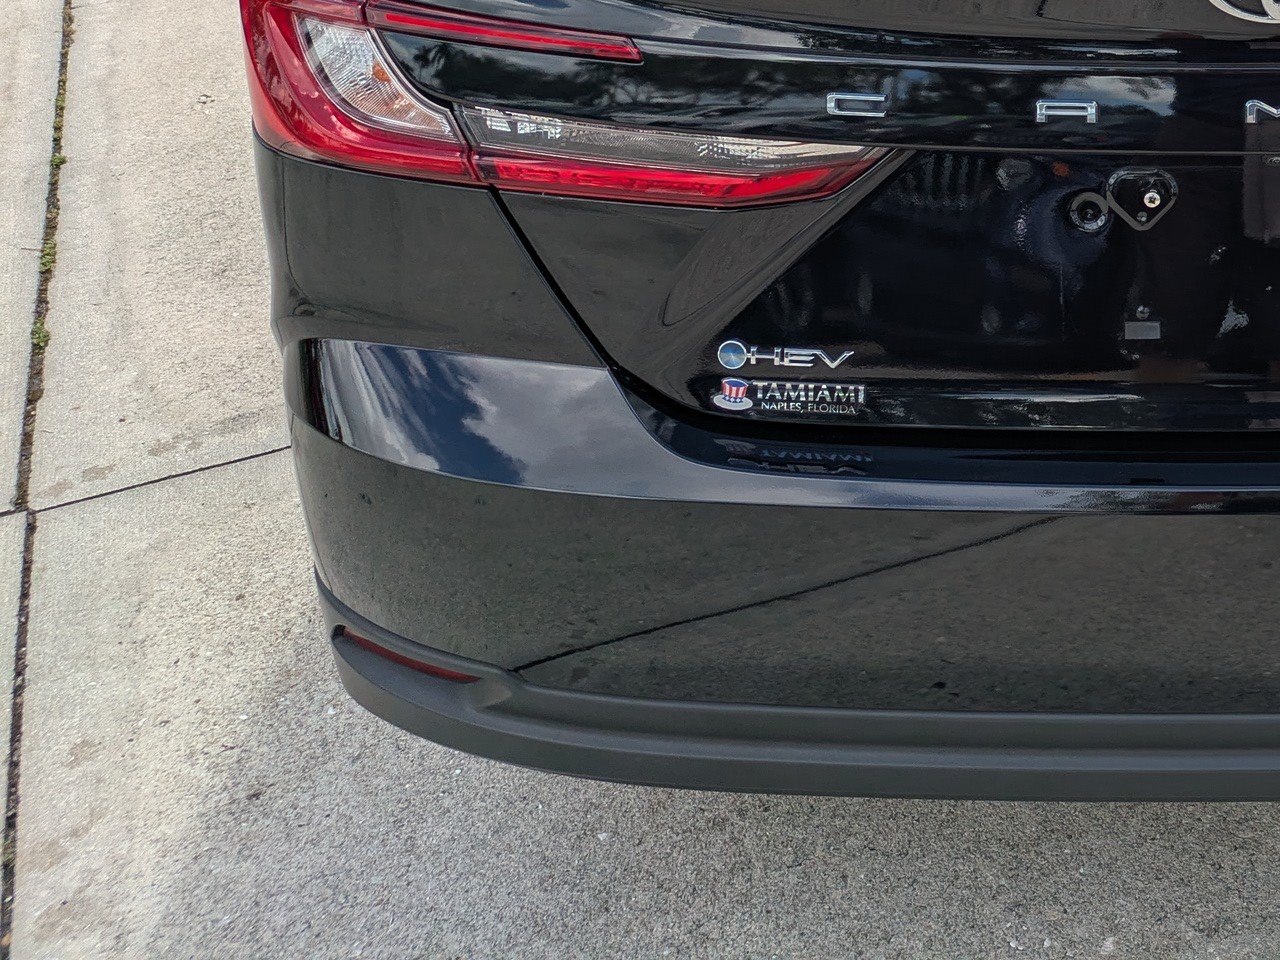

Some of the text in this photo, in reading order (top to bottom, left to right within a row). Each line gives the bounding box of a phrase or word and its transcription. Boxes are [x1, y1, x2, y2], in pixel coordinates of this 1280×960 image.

[750, 346, 855, 369] HEV
[753, 381, 866, 404] TAMIAMI
[761, 401, 856, 414] NAPLES, FLORIDA
